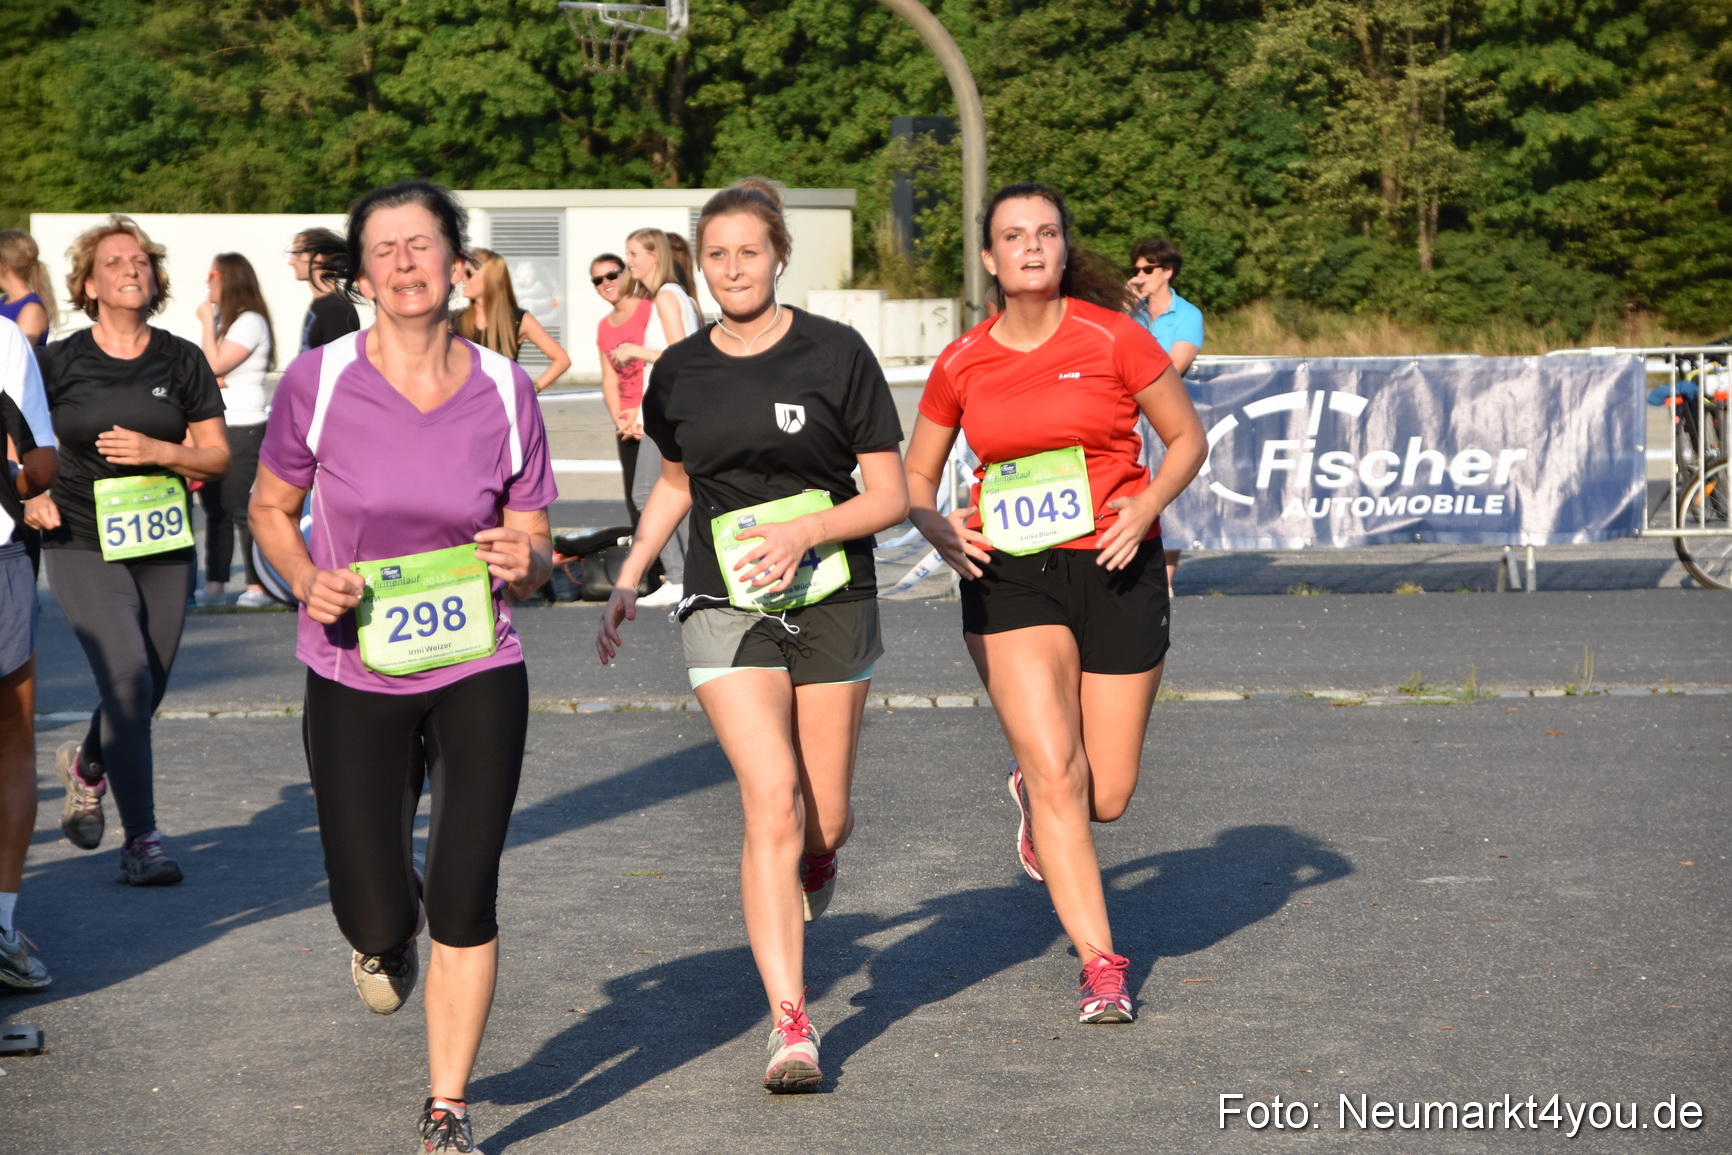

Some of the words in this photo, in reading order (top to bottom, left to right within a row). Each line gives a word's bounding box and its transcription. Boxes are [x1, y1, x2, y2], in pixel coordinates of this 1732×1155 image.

[1256, 436, 1528, 489] Fischer
[993, 488, 1081, 530] 1043
[1282, 494, 1505, 519] AUTOMOBILE
[106, 506, 183, 546] 5189
[1039, 530, 1057, 538] Blank
[373, 574, 420, 589] firmenlauf
[385, 595, 467, 643] 298
[408, 645, 424, 656] Irmi
[425, 642, 452, 653] Weizer
